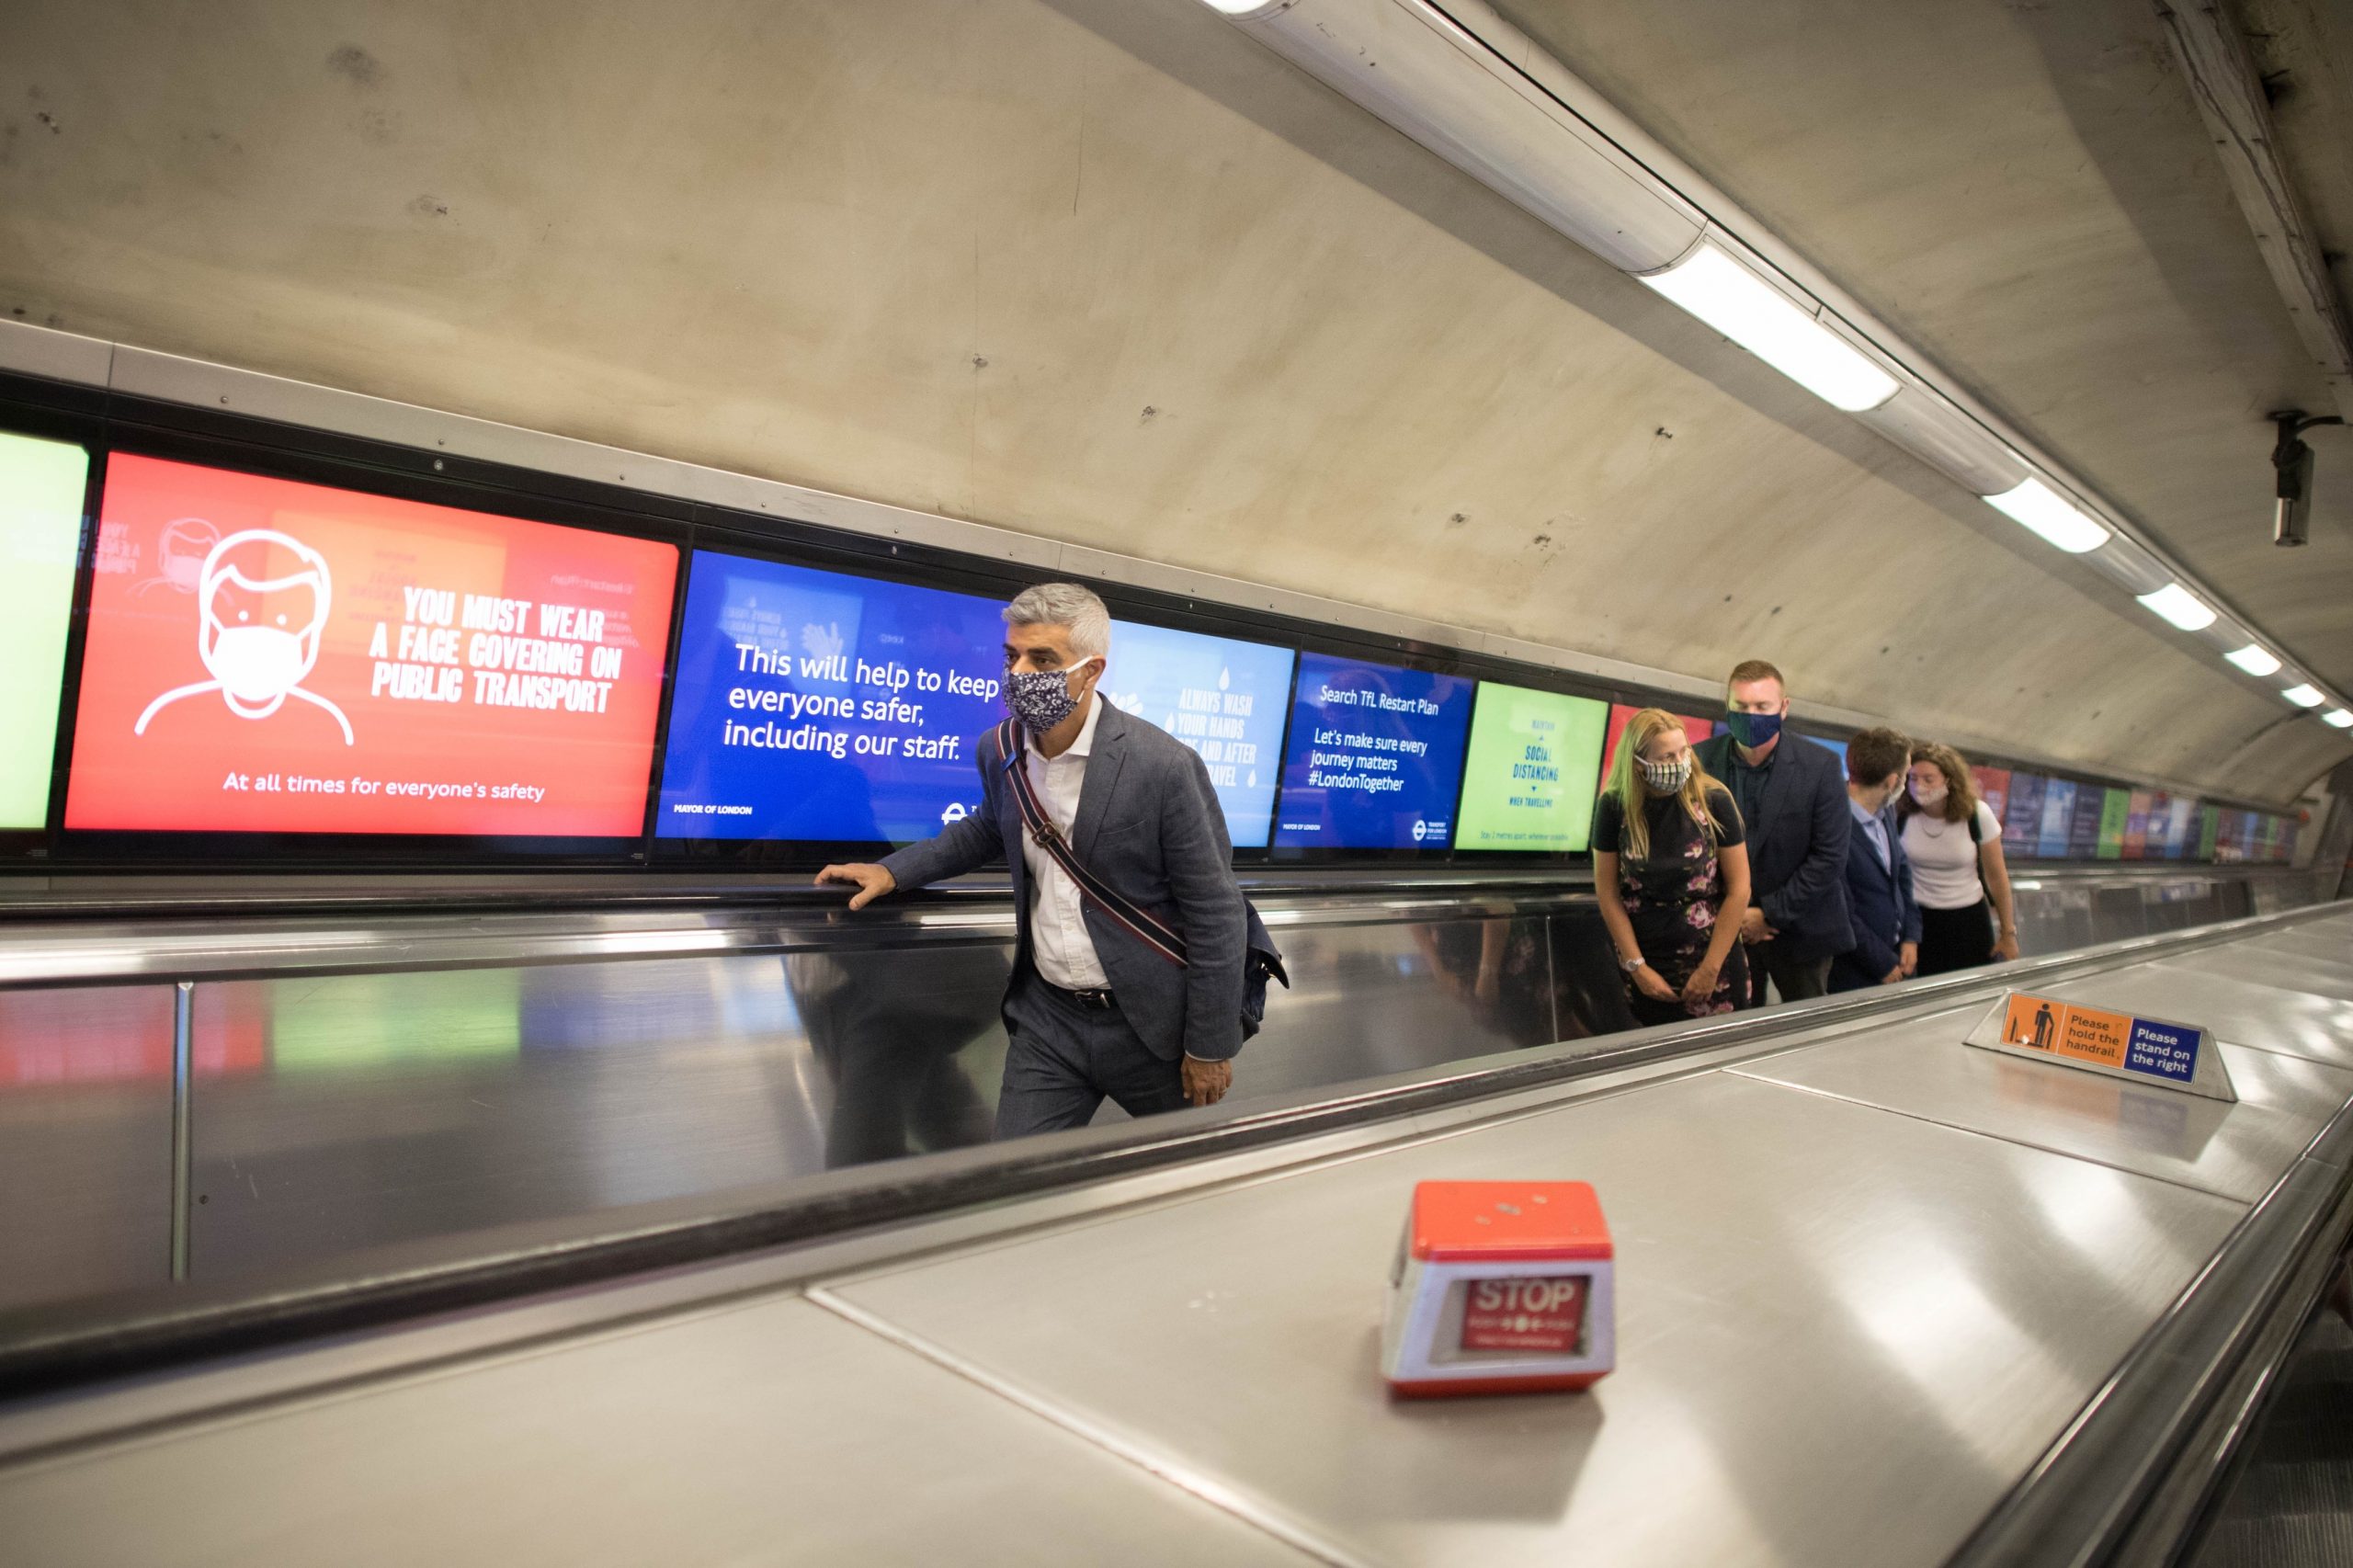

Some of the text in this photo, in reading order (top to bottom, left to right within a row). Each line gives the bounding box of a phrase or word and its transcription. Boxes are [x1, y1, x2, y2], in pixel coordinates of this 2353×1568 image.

[404, 586, 456, 626] YOU
[461, 595, 531, 634] MUST
[540, 604, 606, 642] WEAR
[369, 621, 622, 679] A FACE COVERING ON
[735, 642, 999, 703] This will help to keep
[371, 662, 612, 713] PUBLIC TRANSPORT
[1320, 685, 1439, 716] Search TfL Restart Plan
[729, 687, 924, 727] everyone safer,
[1178, 687, 1254, 717] ALWAYS WASH
[723, 719, 960, 760] including our staff.
[1177, 712, 1245, 740] YOUR HANDS
[1200, 739, 1223, 763] AND
[1224, 743, 1257, 765] AFTER
[1313, 728, 1427, 757] Let's make sure every
[1525, 744, 1552, 763] SOCIAL
[1310, 749, 1398, 771] journey matters
[1513, 763, 1560, 782] DISTANCING
[222, 772, 545, 802] At all times for everyone's safety
[1308, 770, 1404, 793] #LondonTogether
[674, 804, 753, 815] MAYOR OF LONDON
[2069, 1027, 2120, 1046] hold the
[2071, 1014, 2109, 1031] Please
[2137, 1028, 2178, 1045] Please
[2132, 1053, 2188, 1074] the right
[2134, 1041, 2190, 1061] stand on
[1475, 1278, 1574, 1312] STOP
